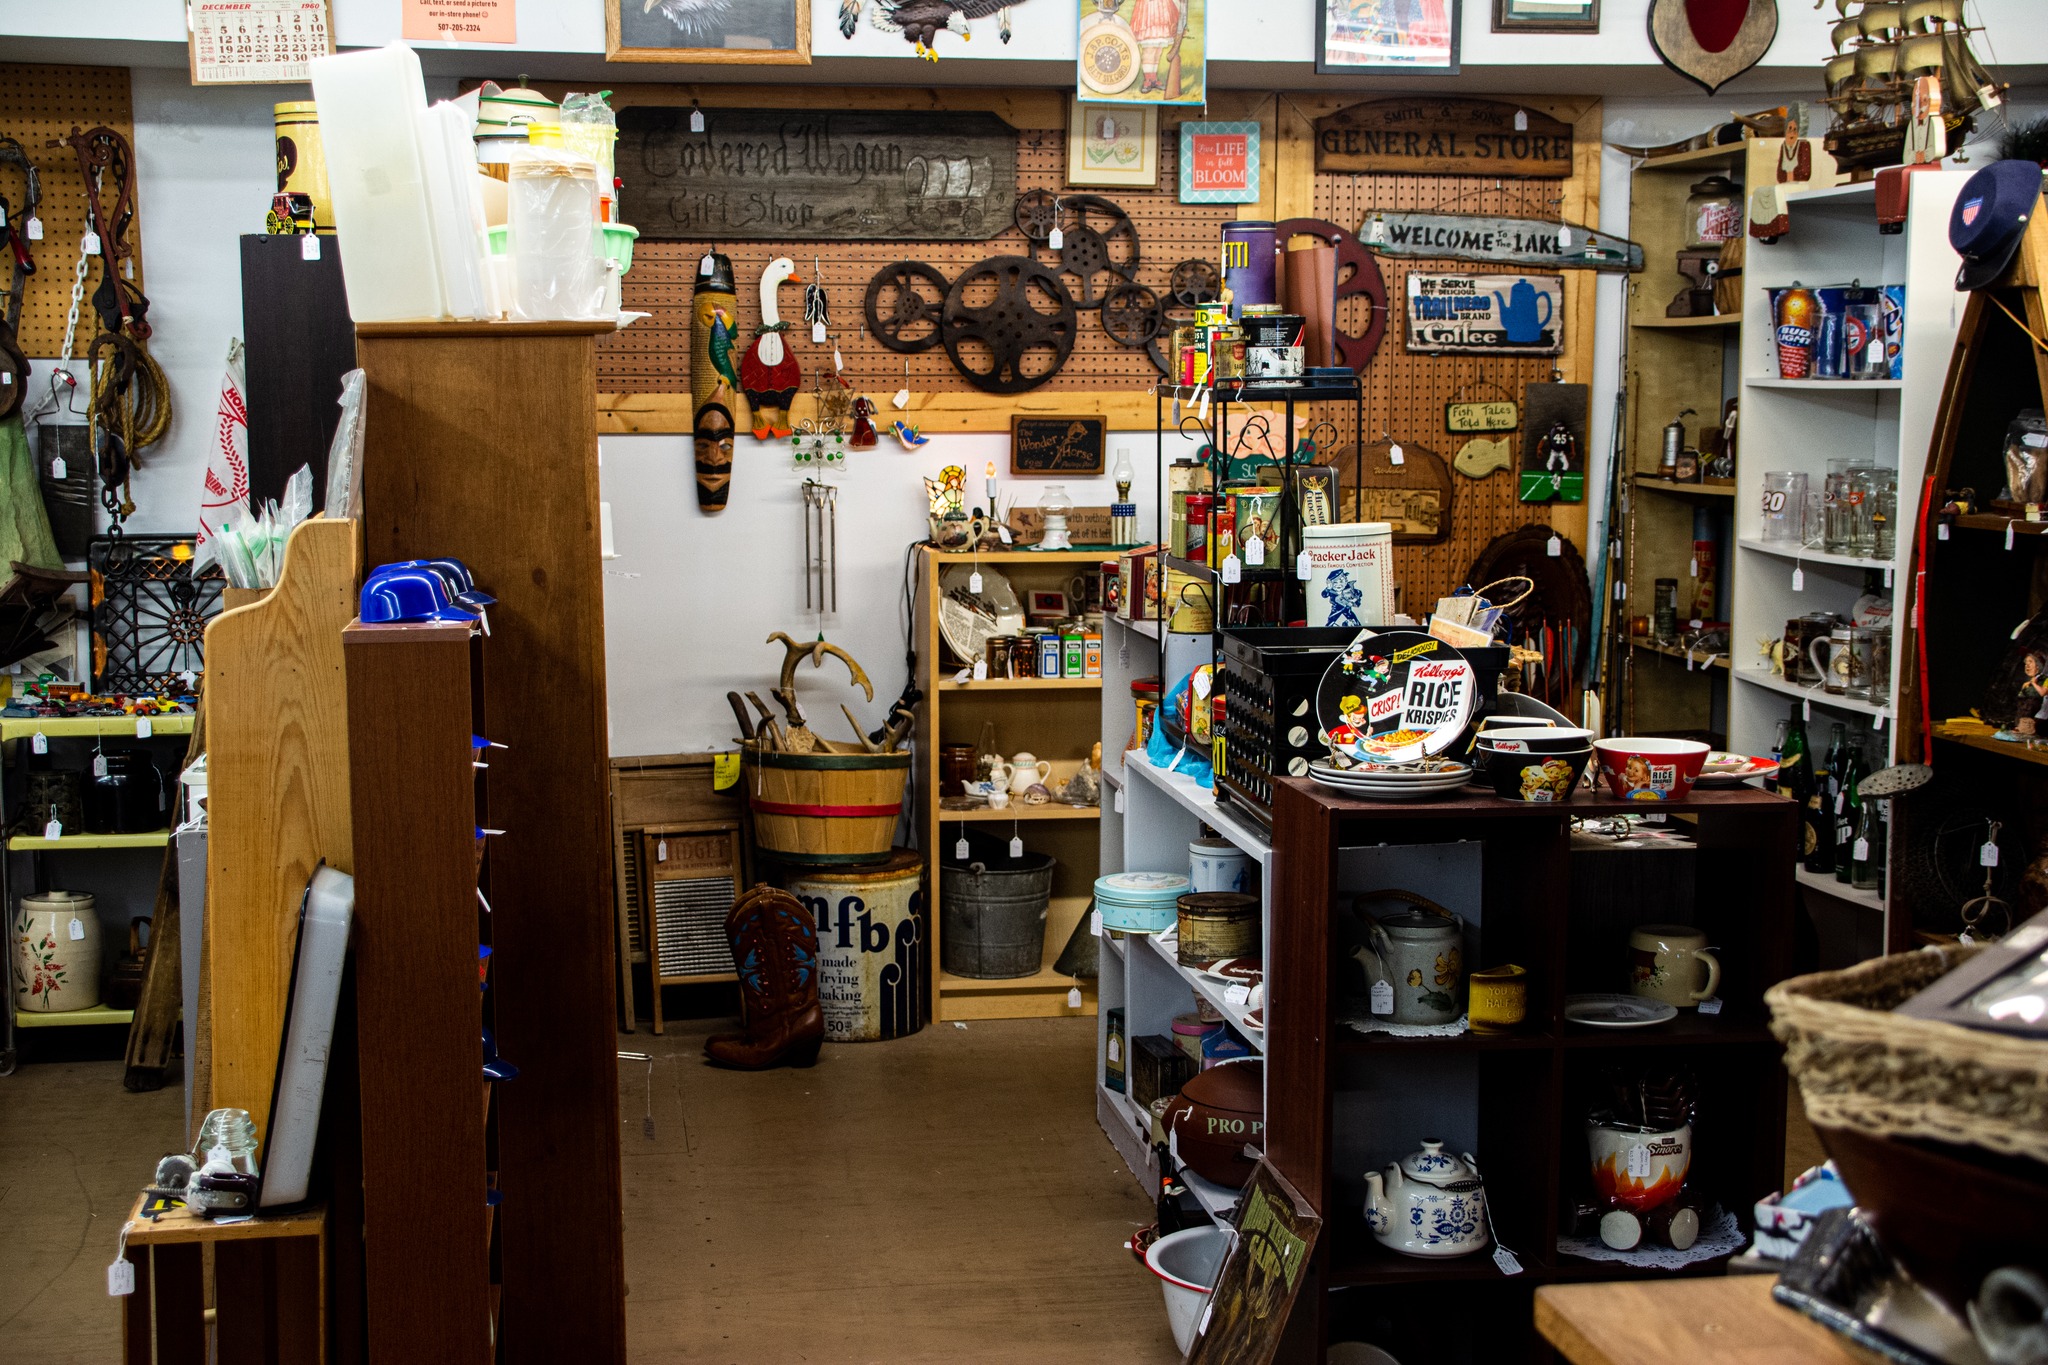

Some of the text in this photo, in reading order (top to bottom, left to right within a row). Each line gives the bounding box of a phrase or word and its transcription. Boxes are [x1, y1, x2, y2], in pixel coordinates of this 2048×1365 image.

[312, 14, 319, 22] 3
[462, 11, 480, 19] phone!
[220, 26, 228, 34] 5
[238, 26, 246, 34] 6
[294, 24, 302, 32] 9
[310, 24, 324, 32] 10
[438, 24, 481, 32] 507-205-2324
[218, 36, 232, 44] 12
[237, 36, 252, 44] 13
[274, 34, 288, 42] 15
[219, 46, 234, 54] 19
[236, 45, 252, 53] 20
[274, 44, 288, 52] 22
[292, 44, 306, 52] 23
[310, 44, 325, 52] 24
[274, 54, 289, 62] 29
[293, 54, 308, 62] 30
[1384, 107, 1504, 126] SMITH & SONS
[640, 117, 904, 185] Covered Wagon
[1216, 142, 1244, 156] LIFE
[1321, 129, 1570, 161] GENERAL STORE
[1206, 157, 1233, 168] in full
[1195, 170, 1245, 183] BLOOM
[668, 188, 815, 231] Gift Shop
[1390, 224, 1494, 250] WELCOME
[1496, 239, 1512, 248] The
[1513, 232, 1562, 254] LAKE
[1420, 278, 1437, 289] WE
[1438, 288, 1476, 296] DELICIOUS
[1460, 312, 1491, 320] BRAND
[1424, 321, 1497, 344] Coffee
[1781, 327, 1810, 336] BUD
[1452, 406, 1474, 416] Fish
[1020, 435, 1058, 451] Wonder
[1553, 434, 1567, 444] 45
[1062, 444, 1093, 460] Horse
[1763, 490, 1786, 512] 20
[1084, 513, 1112, 525] nothing
[1308, 548, 1376, 562] Cracker Jack
[1396, 642, 1436, 662] DELICIOUS!
[1414, 662, 1466, 682] Kellogg's
[1408, 680, 1462, 708] RICE
[1372, 692, 1400, 718] CRISP!
[1405, 708, 1457, 726] KRISPIES
[1495, 742, 1520, 751] Kellogg's
[1652, 771, 1672, 779] RICE
[822, 956, 857, 968] made
[820, 972, 859, 988] frying
[818, 989, 862, 1004] baking
[1488, 987, 1508, 996] YOU
[828, 1020, 844, 1032] 50
[1207, 1118, 1245, 1134] PRO
